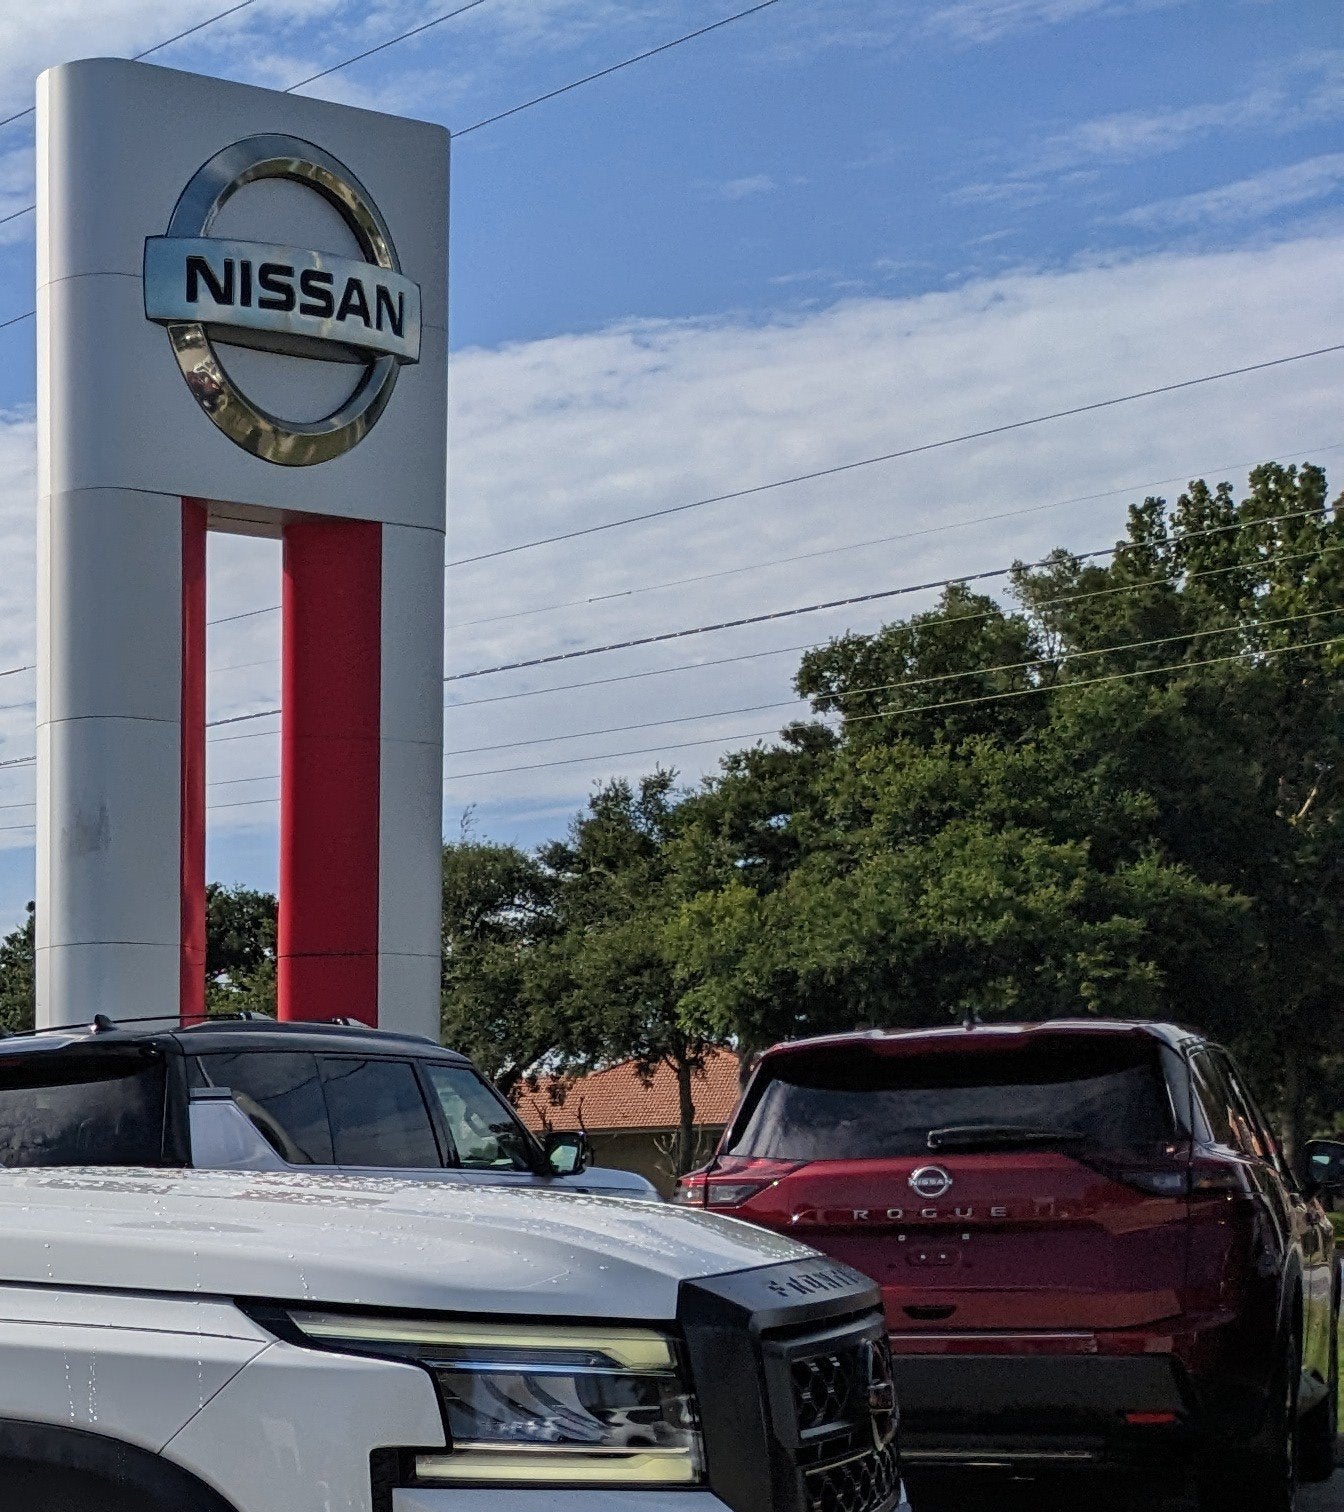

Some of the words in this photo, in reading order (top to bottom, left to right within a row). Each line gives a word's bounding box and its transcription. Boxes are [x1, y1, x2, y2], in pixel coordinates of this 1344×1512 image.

[185, 255, 405, 338] NISSAN
[909, 1177, 953, 1187] NISSAN
[853, 1206, 1007, 1220] ROGUE
